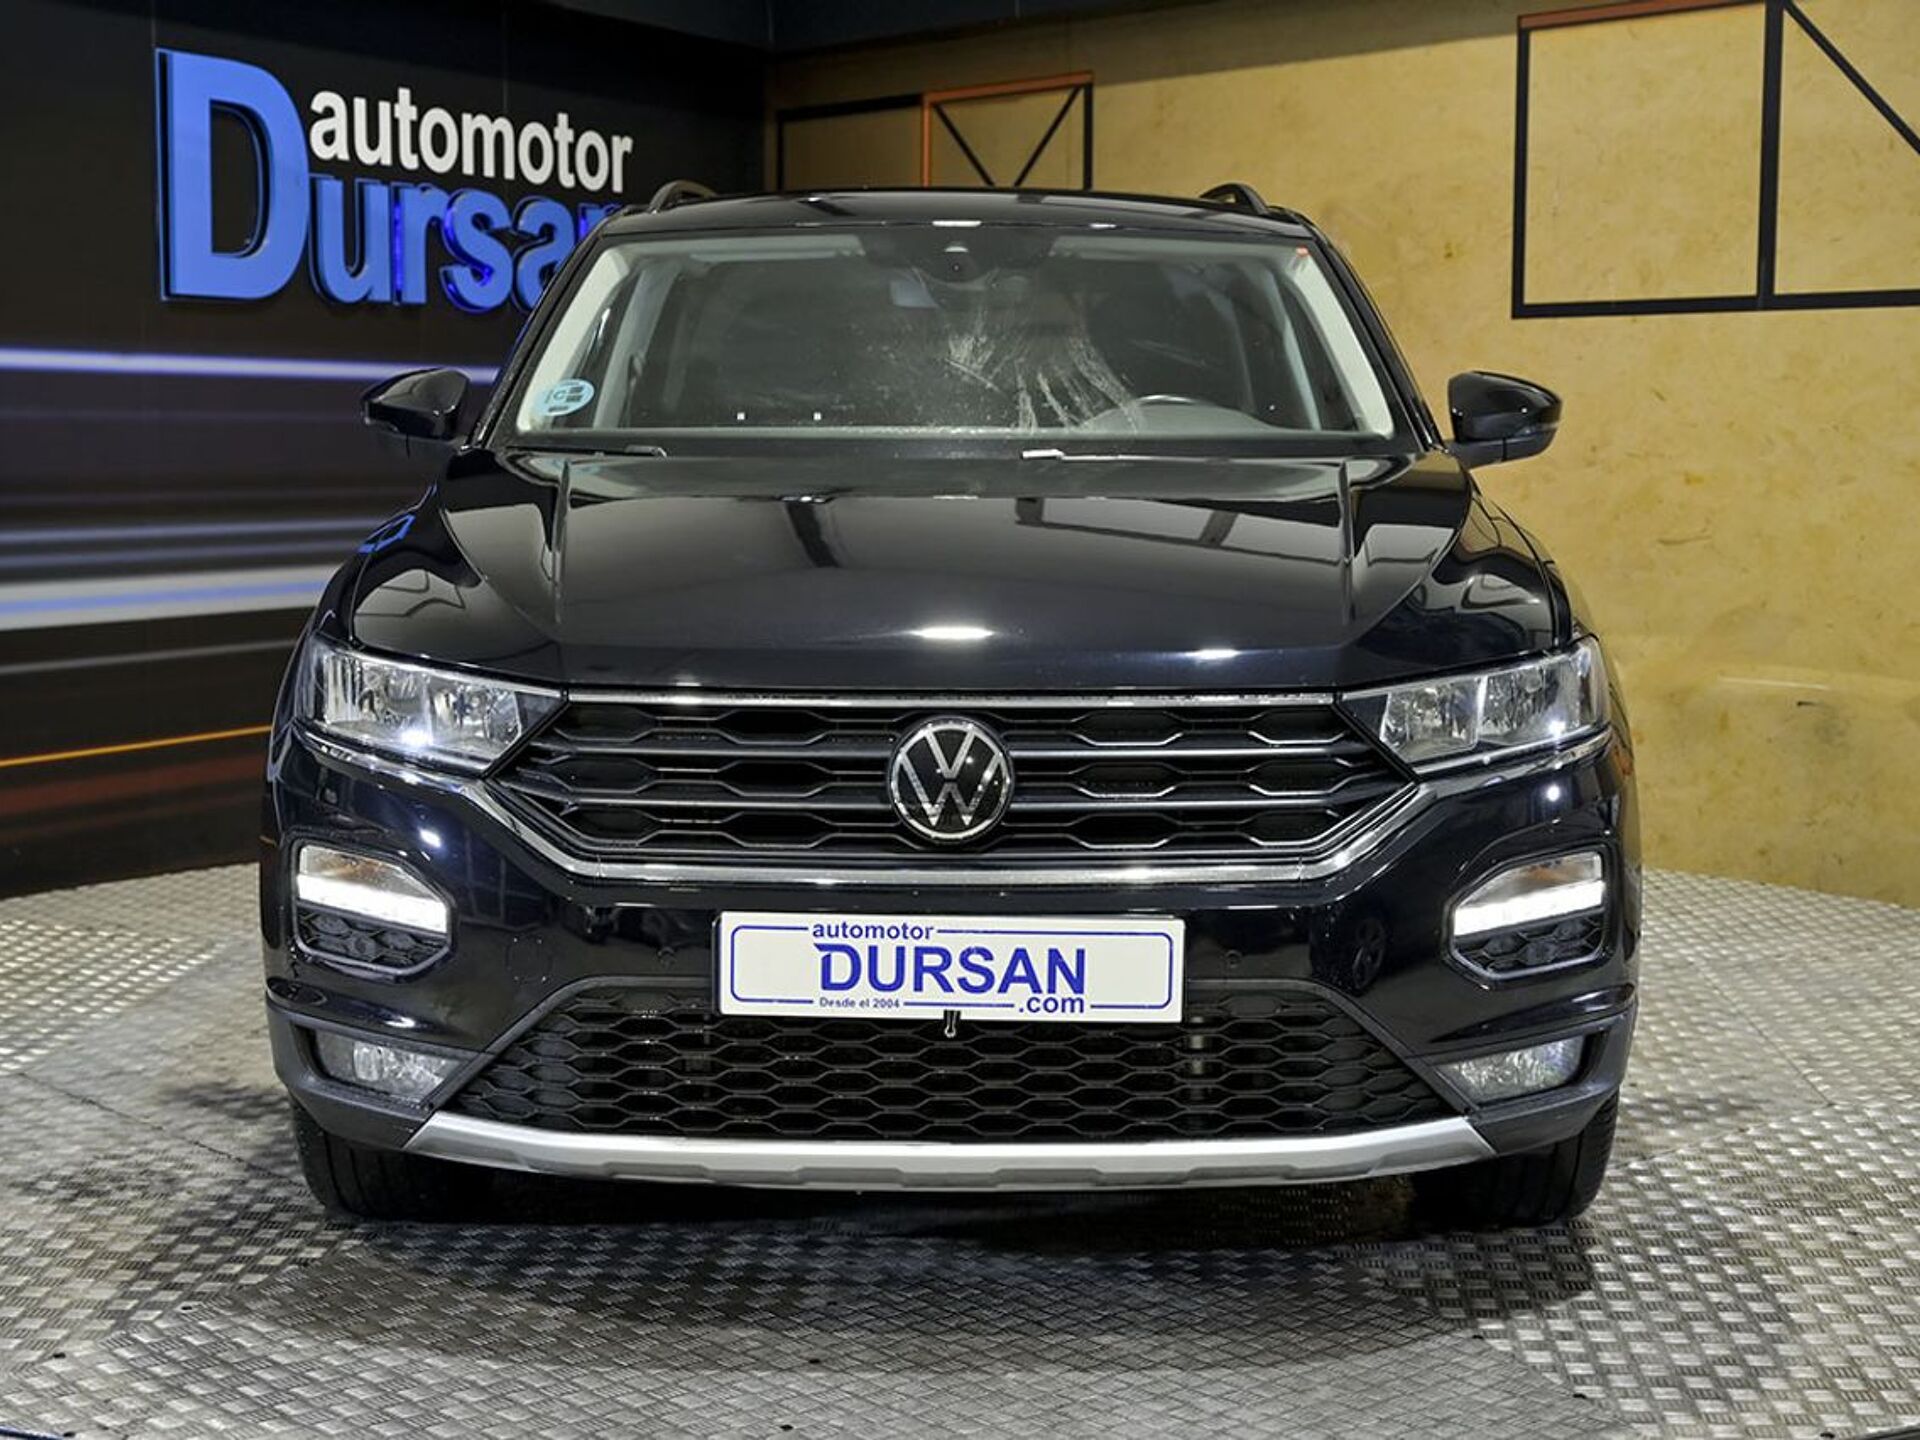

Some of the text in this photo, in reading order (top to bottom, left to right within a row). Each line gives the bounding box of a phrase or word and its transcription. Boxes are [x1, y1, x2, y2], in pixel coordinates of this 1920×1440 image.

[309, 87, 634, 194] automotor
[154, 47, 622, 313] Dursa
[896, 724, 1006, 832] VW
[812, 922, 934, 941] automotor
[813, 942, 1086, 995] DURSAN
[819, 996, 900, 1009] Desde el 2004
[1018, 996, 1085, 1014] .com
